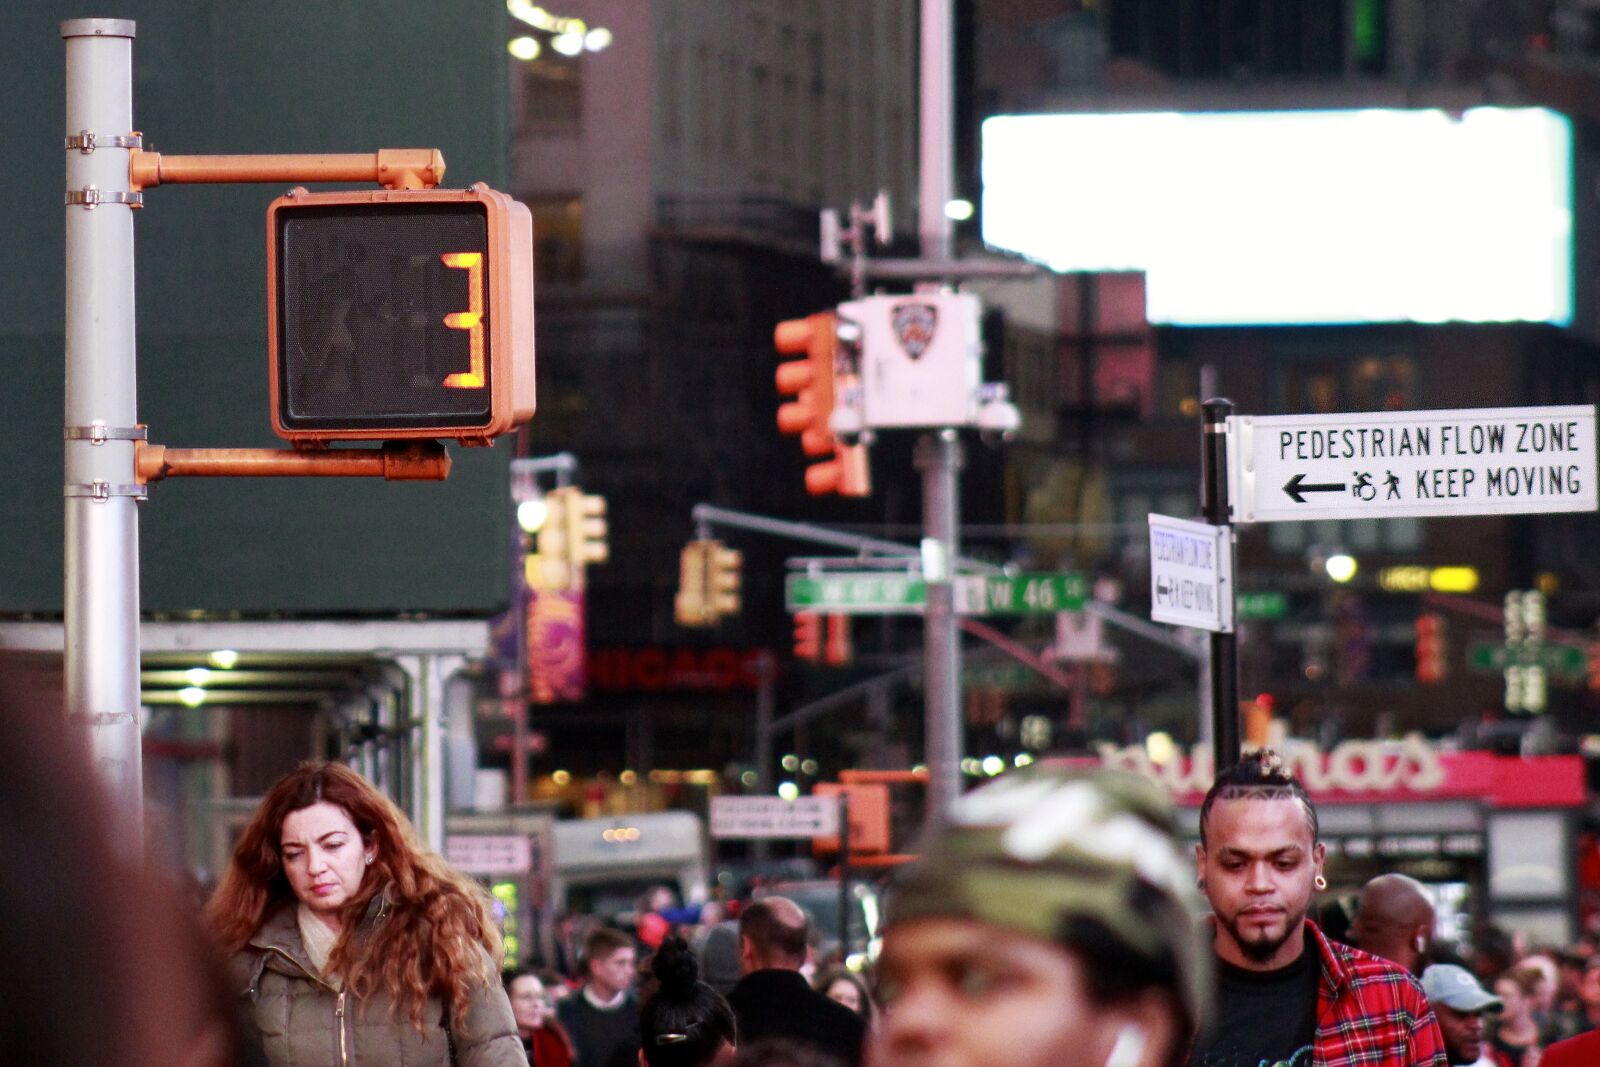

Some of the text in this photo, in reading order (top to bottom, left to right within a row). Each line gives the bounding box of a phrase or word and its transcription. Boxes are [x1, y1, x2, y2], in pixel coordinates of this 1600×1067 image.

[441, 252, 485, 389] 3
[1280, 422, 1579, 459] PEDESTRIAN FLOW ZONE
[1416, 464, 1580, 499] KEEP MOVING
[1022, 579, 1055, 609] 46
